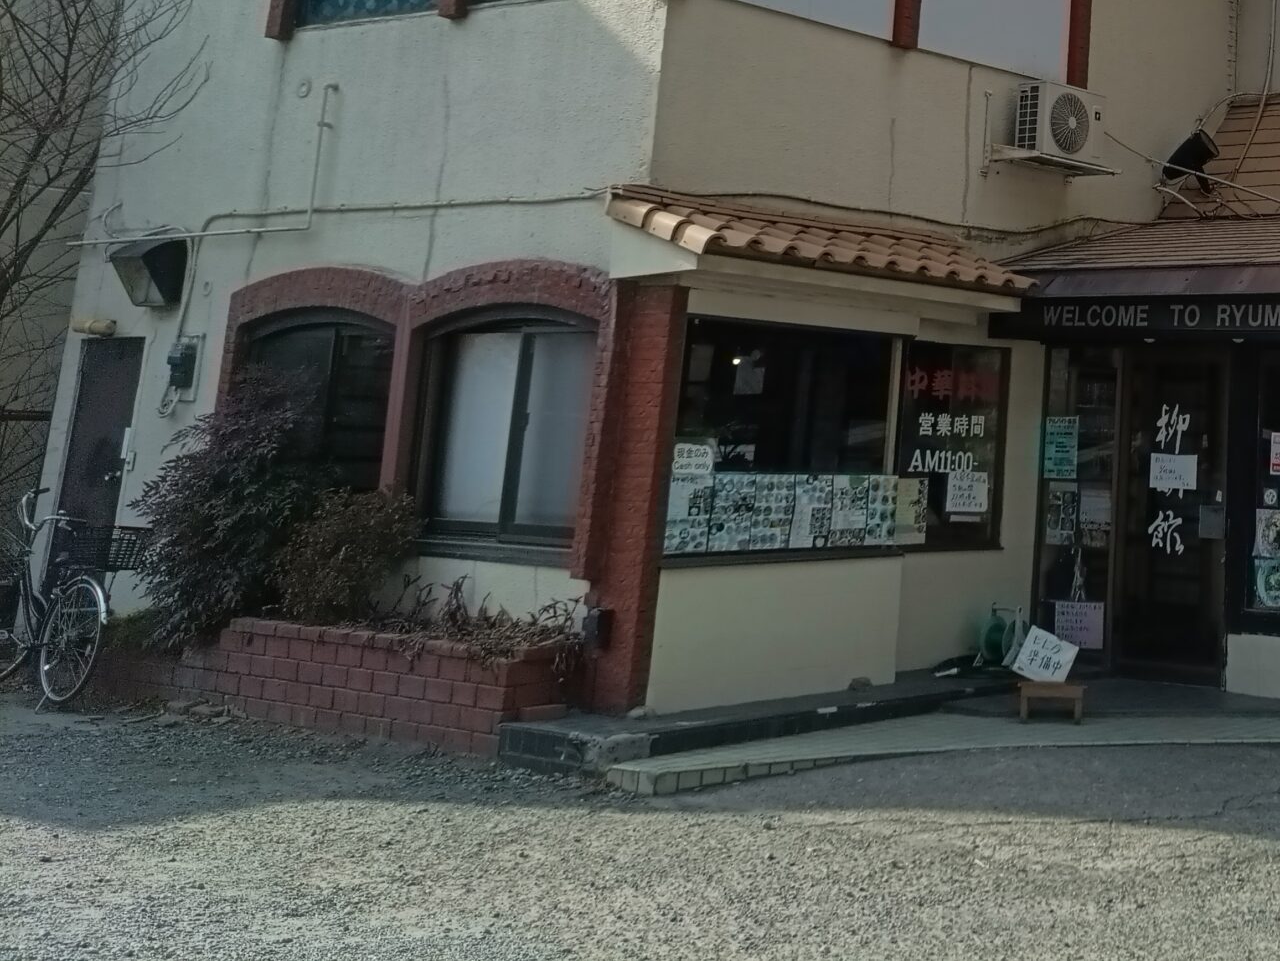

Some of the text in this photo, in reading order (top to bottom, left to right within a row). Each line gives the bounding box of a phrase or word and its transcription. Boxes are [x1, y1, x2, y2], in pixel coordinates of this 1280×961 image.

[1043, 304, 1149, 327] WELCOME
[1170, 304, 1200, 327] TO
[918, 412, 985, 438] 営業時間
[677, 447, 709, 459] 現金のみ
[673, 461, 711, 471] Cash only
[1148, 403, 1191, 556] 柳館
